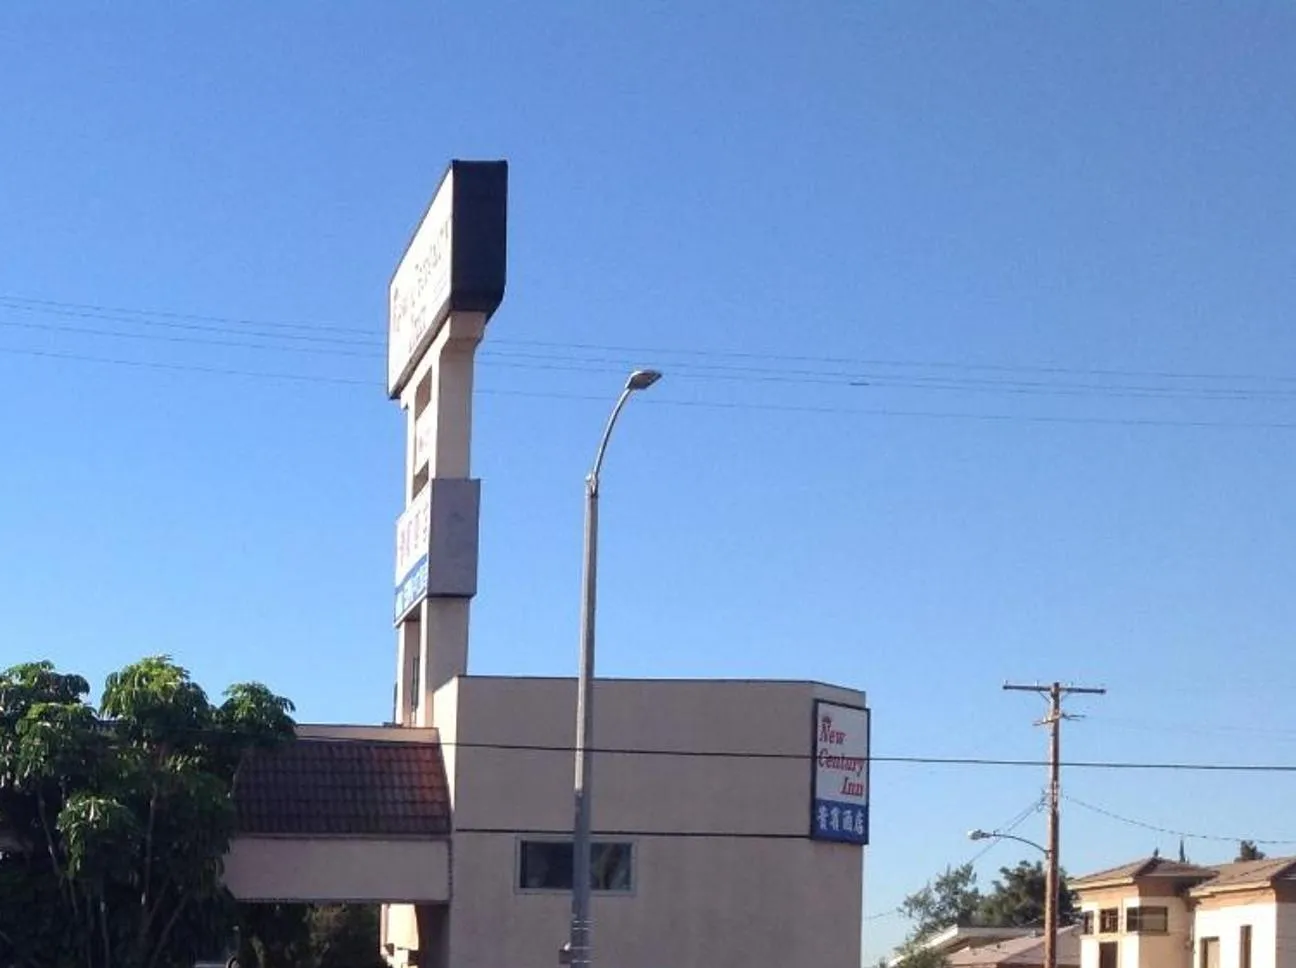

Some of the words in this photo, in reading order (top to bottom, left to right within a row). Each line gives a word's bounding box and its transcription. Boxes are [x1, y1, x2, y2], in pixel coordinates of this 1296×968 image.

[819, 723, 846, 744] New
[819, 748, 864, 776] Century
[840, 777, 864, 796] Inn
